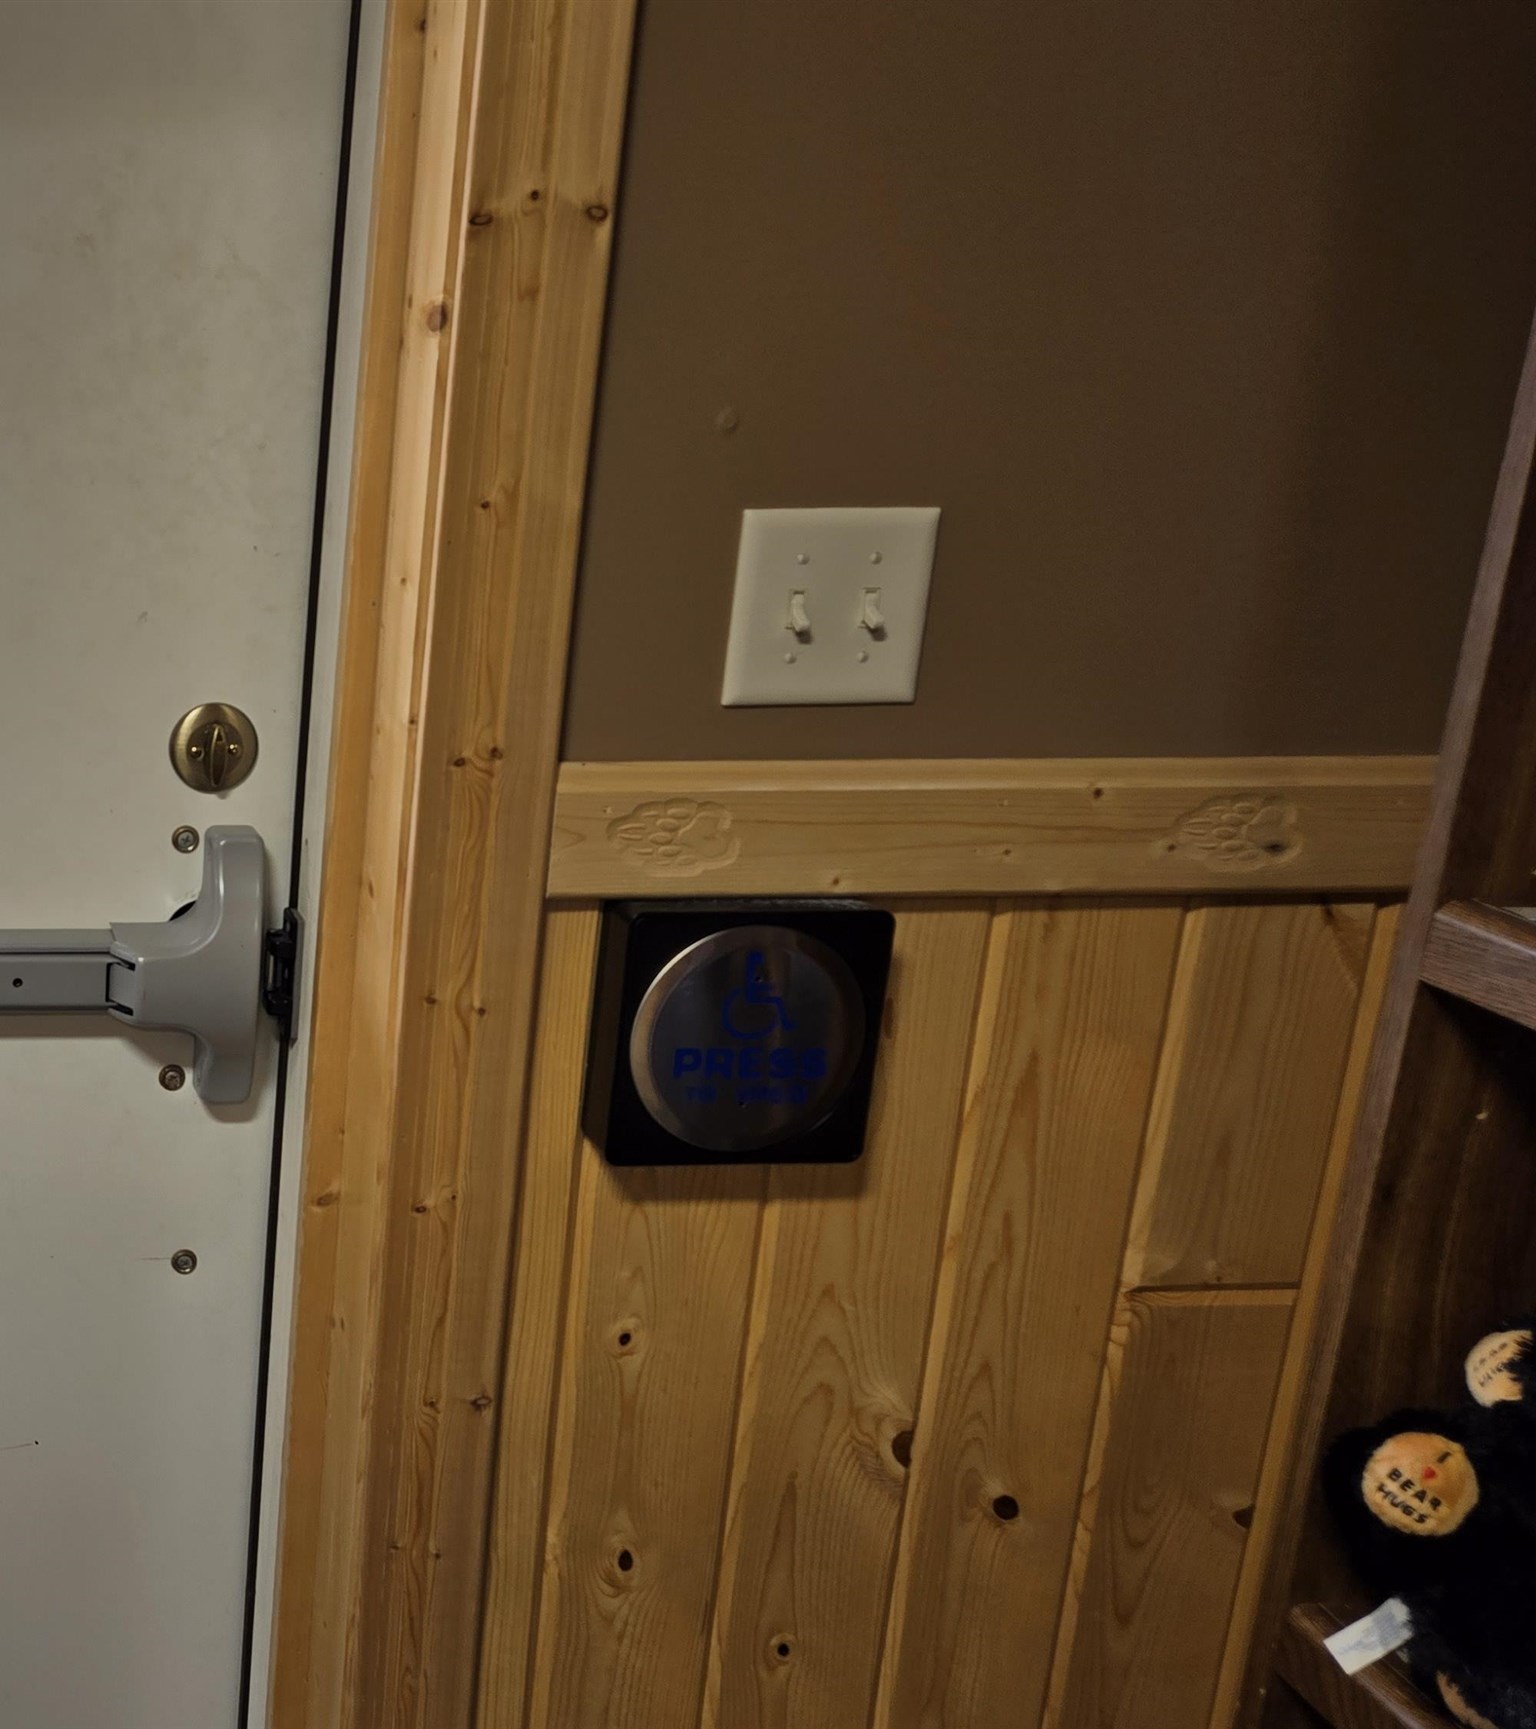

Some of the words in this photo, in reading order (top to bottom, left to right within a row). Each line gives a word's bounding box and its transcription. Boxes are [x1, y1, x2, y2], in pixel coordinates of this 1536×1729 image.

[673, 1047, 828, 1080] PRESS
[1436, 1451, 1452, 1464] I
[1376, 1483, 1428, 1524] HUGS
[1387, 1467, 1442, 1511] BEAR
